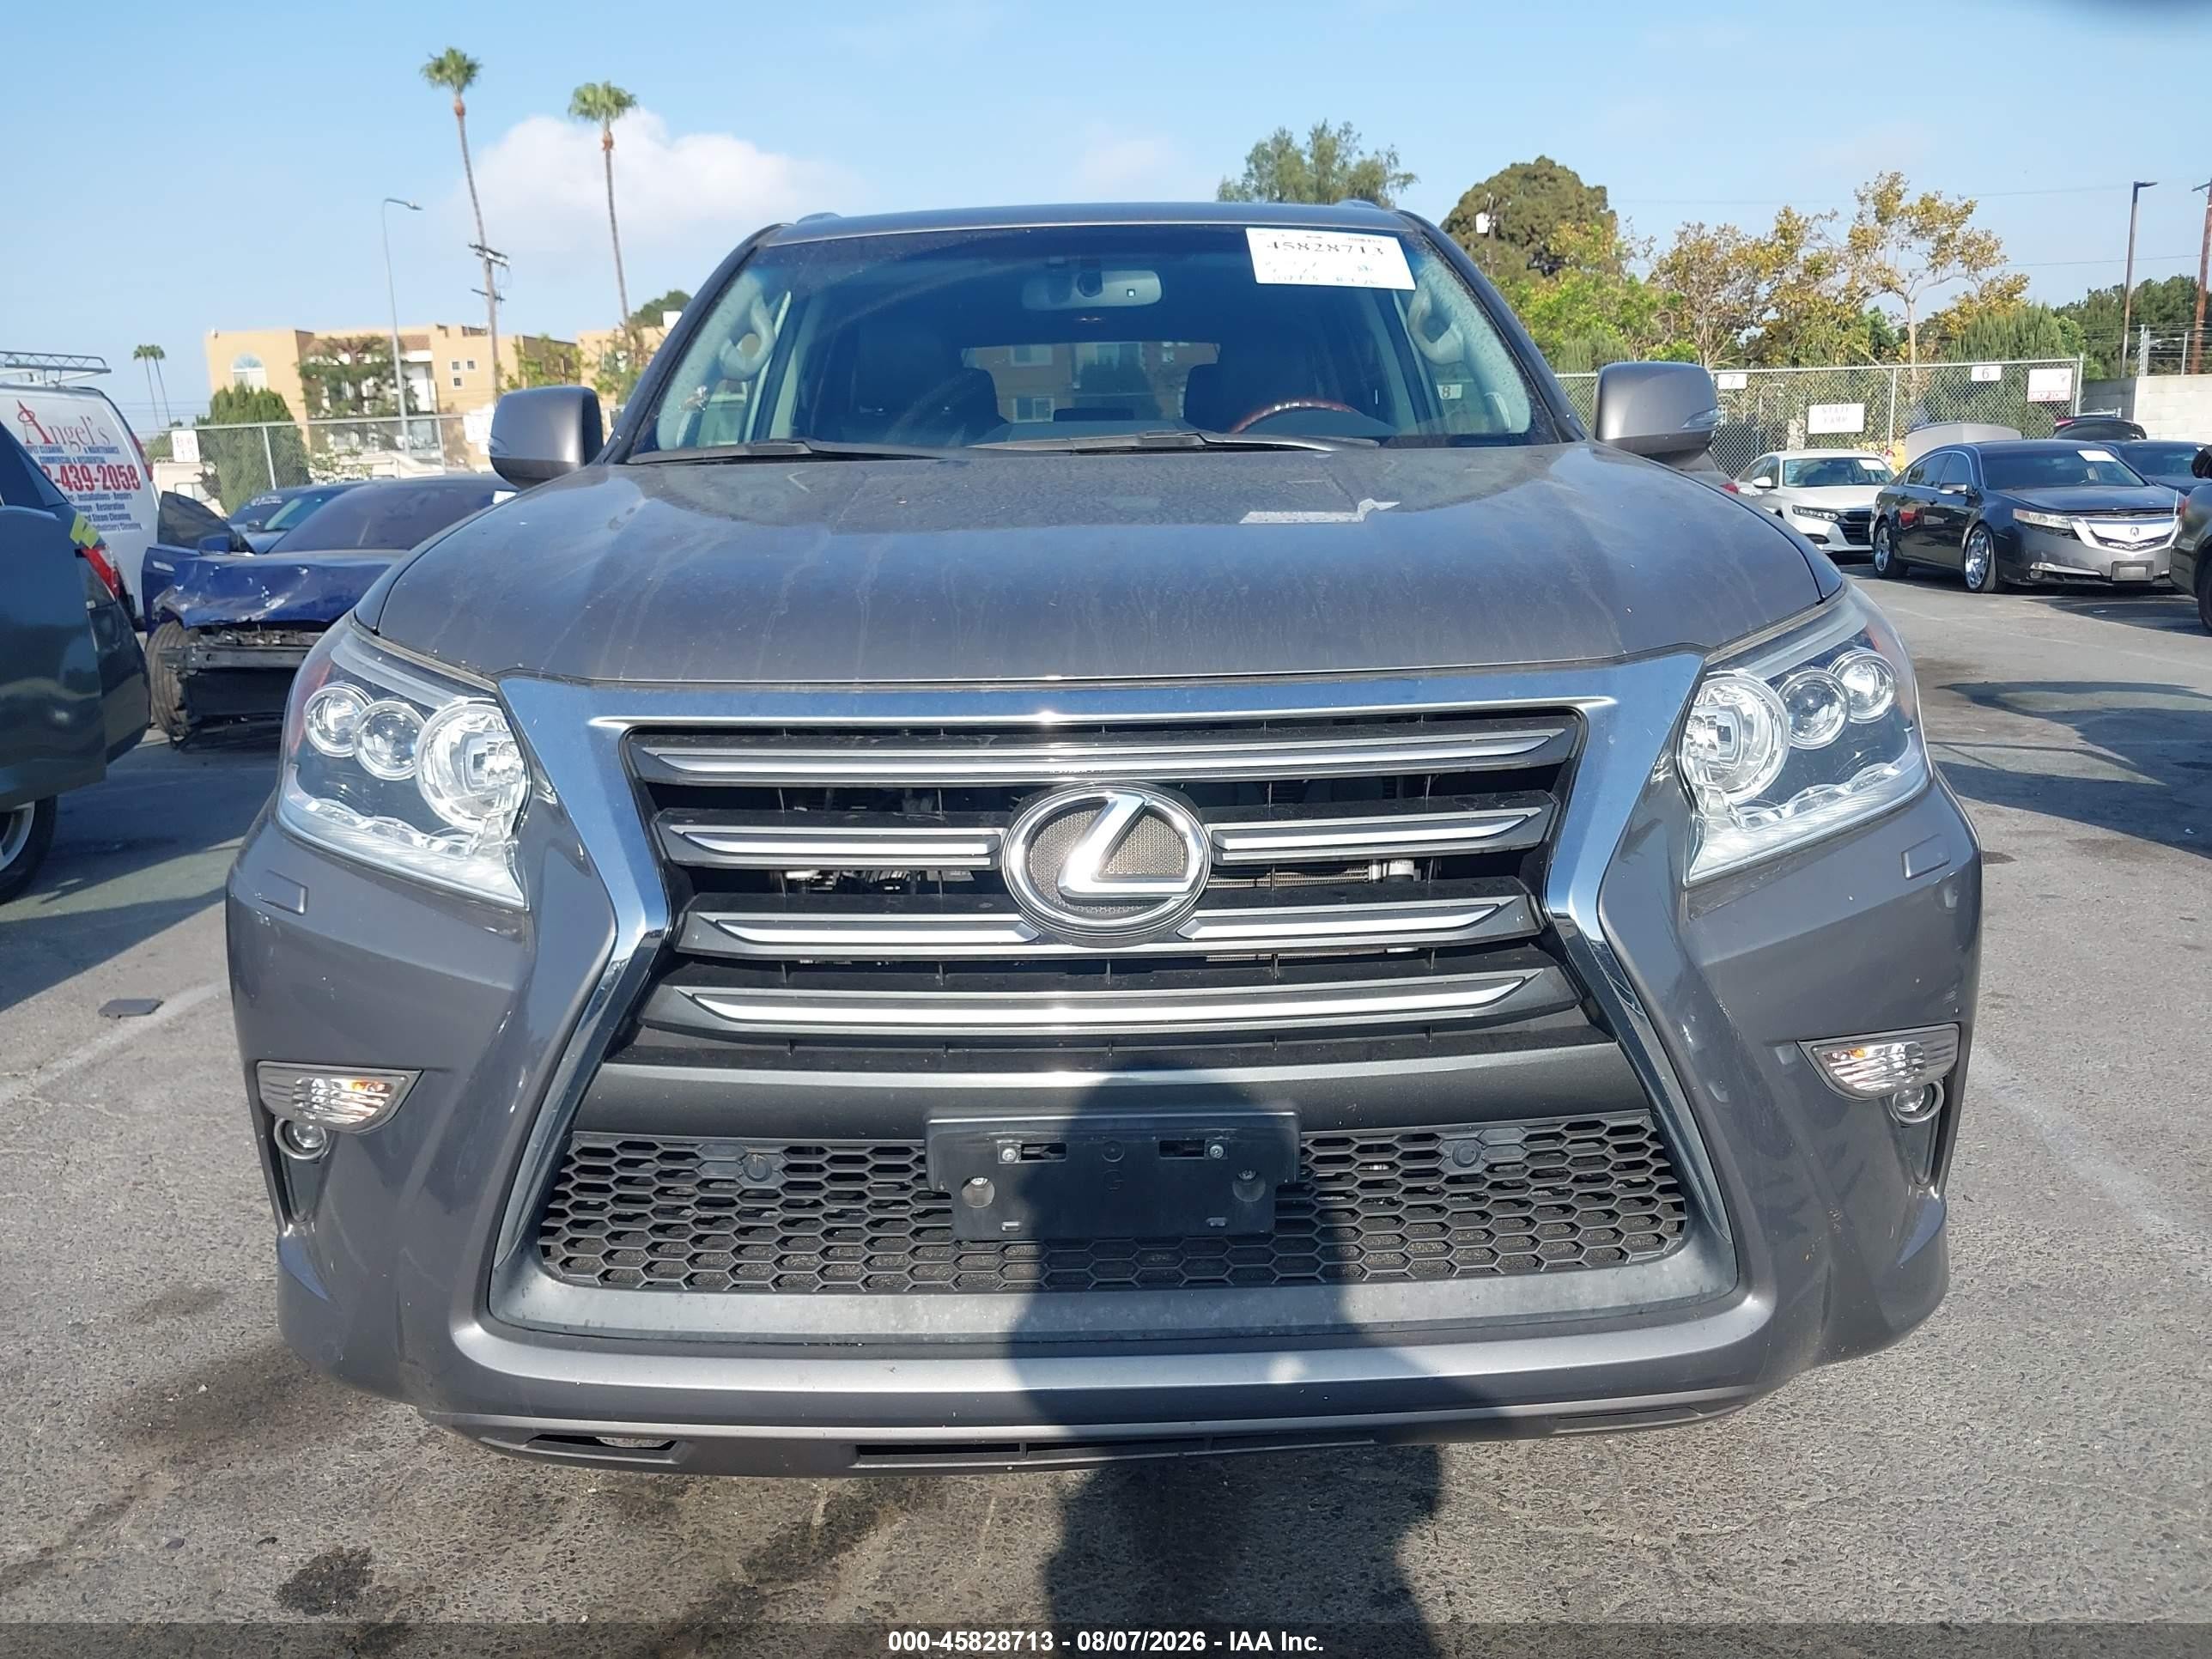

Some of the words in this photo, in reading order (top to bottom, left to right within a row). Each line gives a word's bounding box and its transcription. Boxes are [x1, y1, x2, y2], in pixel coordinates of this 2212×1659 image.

[1982, 368, 1990, 380] 6
[1729, 375, 1735, 386] 7
[1443, 386, 1451, 398] 8
[17, 400, 110, 453] Angel's
